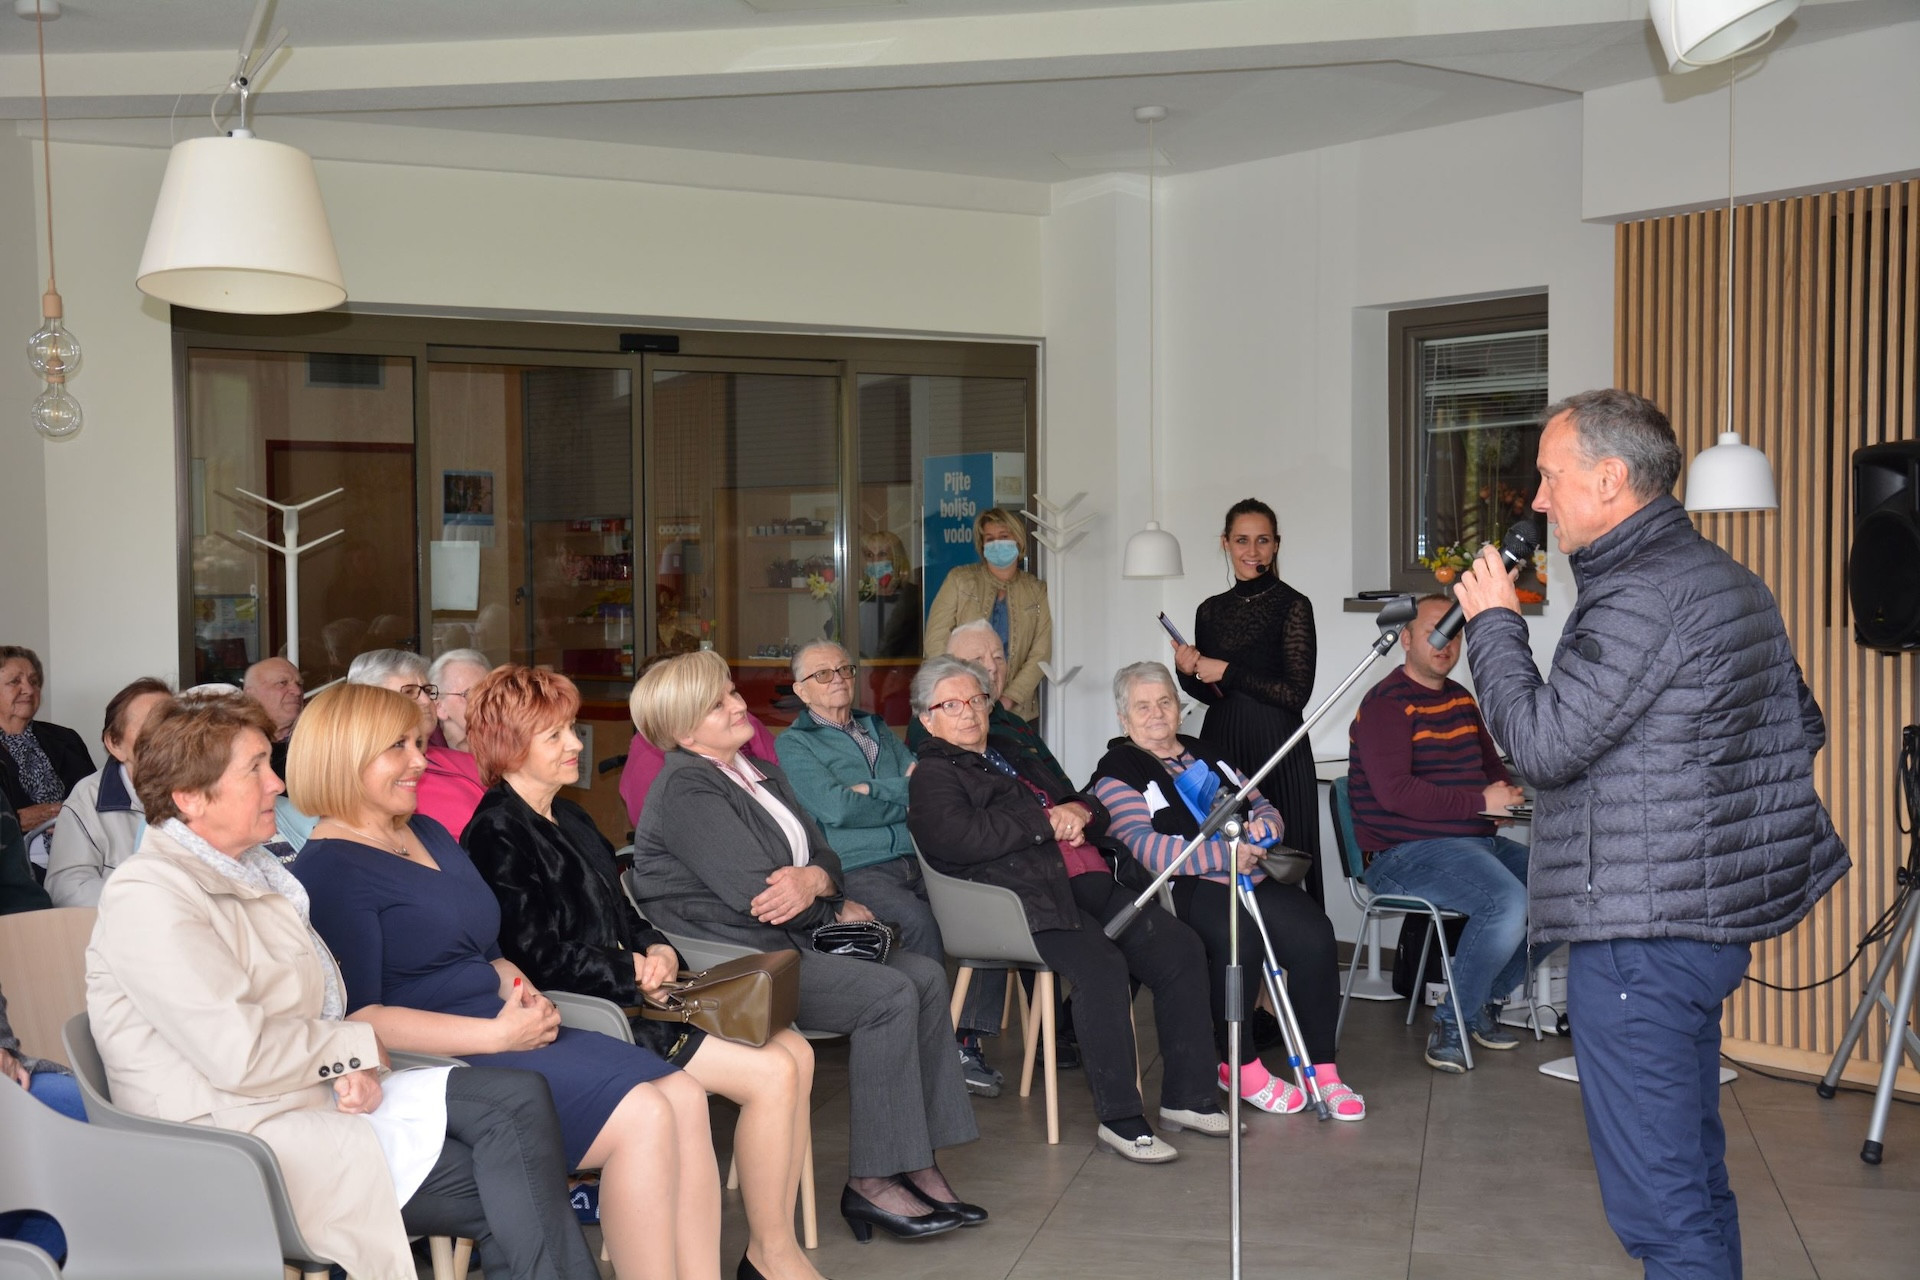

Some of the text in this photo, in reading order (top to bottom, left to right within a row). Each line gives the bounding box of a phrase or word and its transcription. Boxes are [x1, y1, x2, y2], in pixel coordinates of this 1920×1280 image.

[944, 471, 971, 495] Pijte
[940, 497, 976, 521] boljšo
[944, 524, 972, 543] vodo
